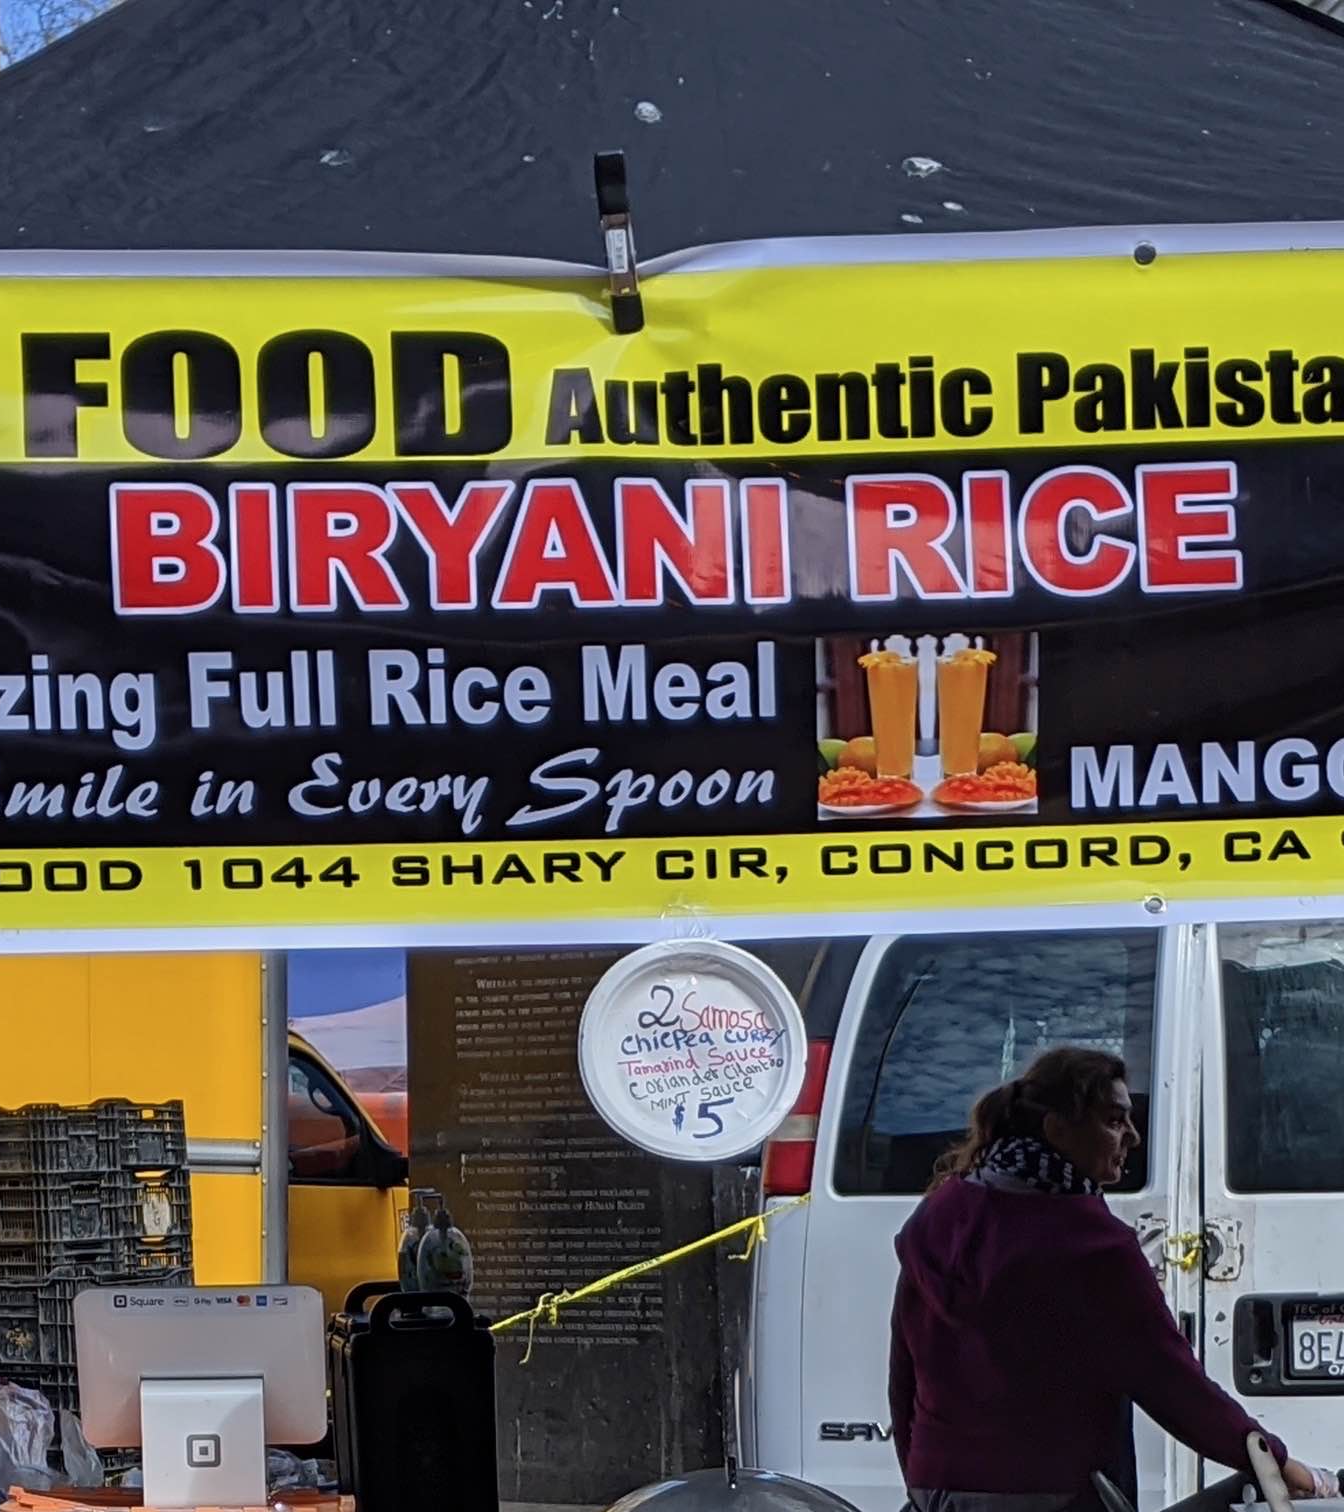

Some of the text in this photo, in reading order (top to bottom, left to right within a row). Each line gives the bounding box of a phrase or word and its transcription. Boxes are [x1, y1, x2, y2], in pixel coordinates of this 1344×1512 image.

[21, 329, 513, 460] FOOD
[544, 357, 993, 446] Authentic
[108, 461, 1242, 616] BIRYANI RICE
[189, 650, 336, 731] Full
[369, 646, 552, 727] Rice
[581, 640, 776, 721] Meal
[191, 765, 256, 815] in
[288, 752, 484, 834] Every
[505, 748, 776, 832] Spoon
[183, 857, 362, 891] 1044
[390, 851, 627, 886] SHARY
[653, 847, 789, 884] CIR,
[818, 831, 1194, 878] CONCORD,
[1222, 823, 1311, 864] CA
[618, 1050, 699, 1077] Tamarind
[130, 1297, 164, 1307] Square
